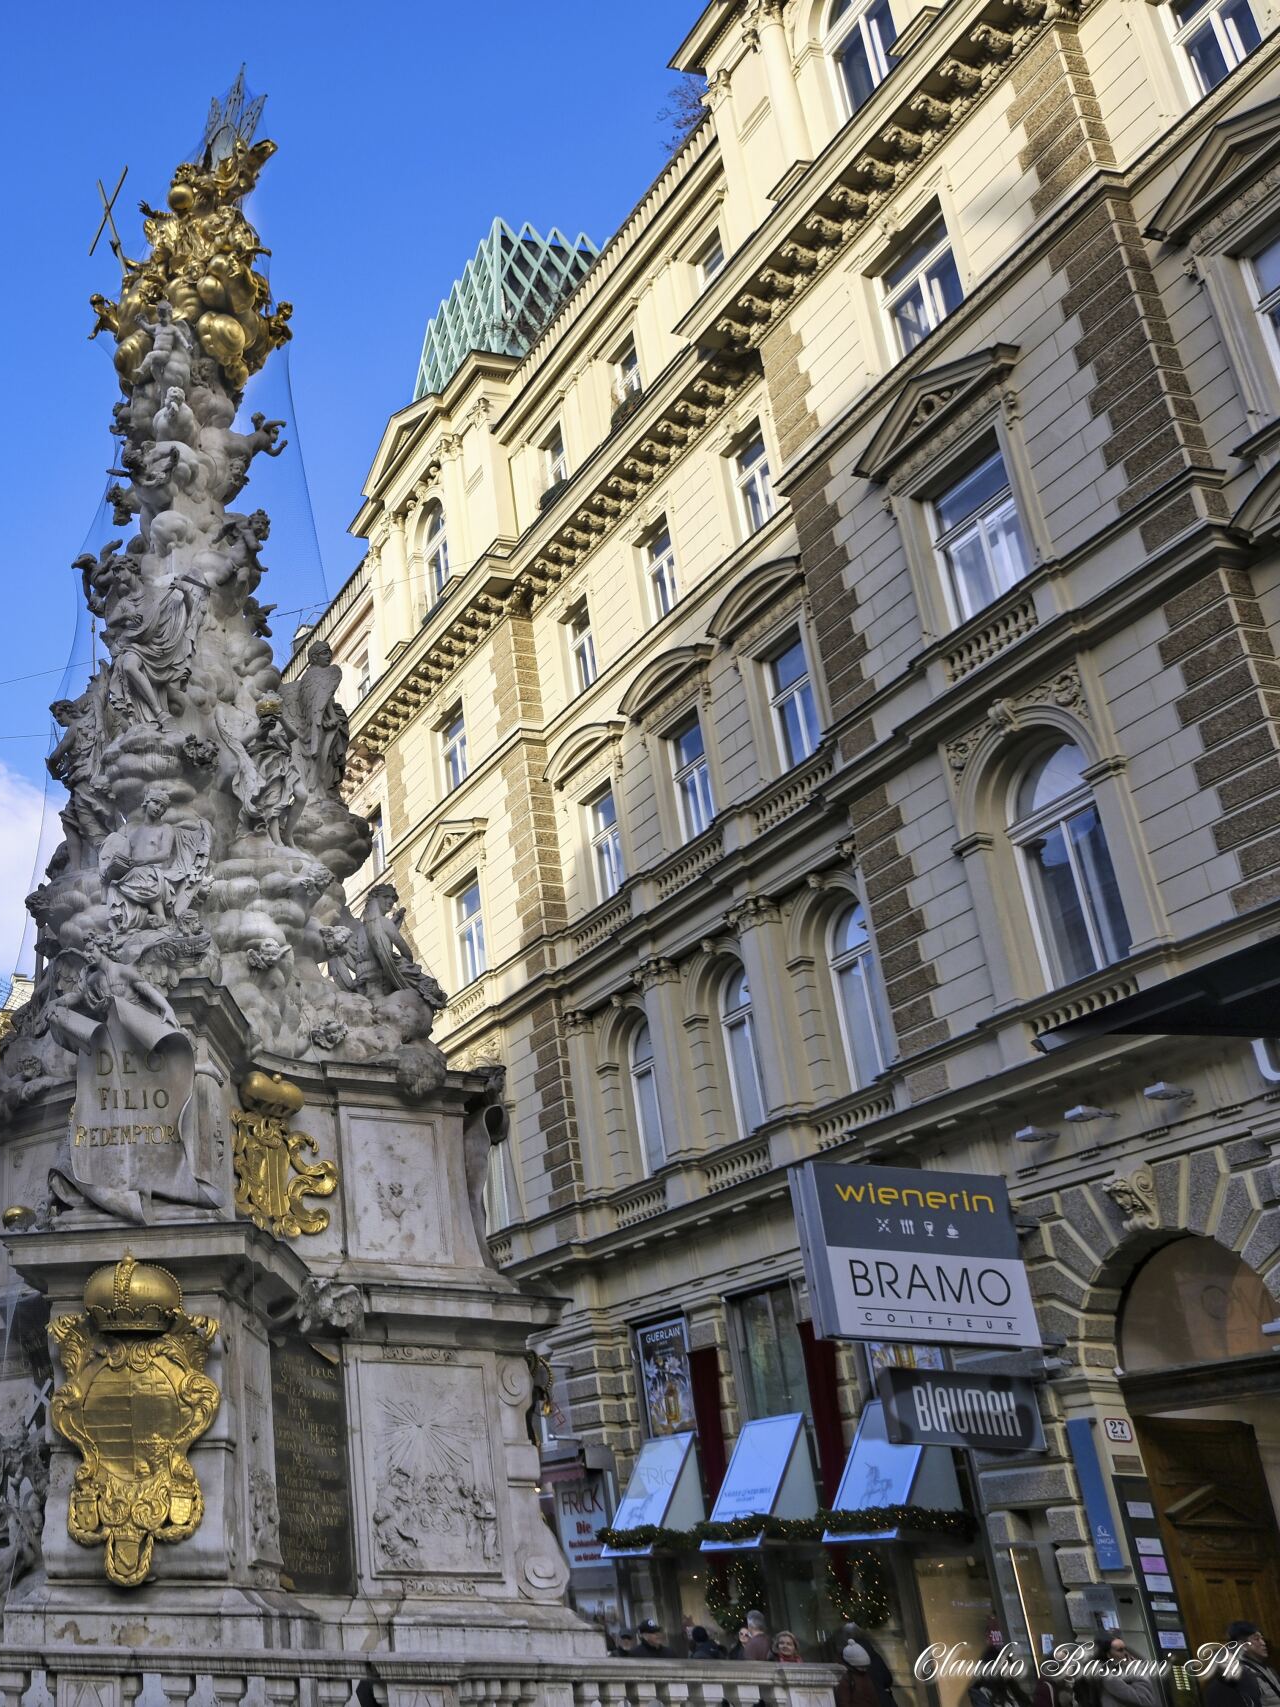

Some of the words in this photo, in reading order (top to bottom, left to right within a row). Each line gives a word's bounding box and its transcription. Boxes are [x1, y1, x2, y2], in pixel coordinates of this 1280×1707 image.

[96, 1049, 165, 1076] DEO
[98, 1087, 170, 1111] FILIO
[835, 1182, 994, 1213] wienerin
[849, 1259, 1011, 1306] BRAMO
[865, 1312, 1013, 1330] COIFFEUR
[646, 1326, 680, 1343] GUERLAIN
[1109, 1420, 1125, 1434] 27
[561, 1484, 603, 1515] FRICK
